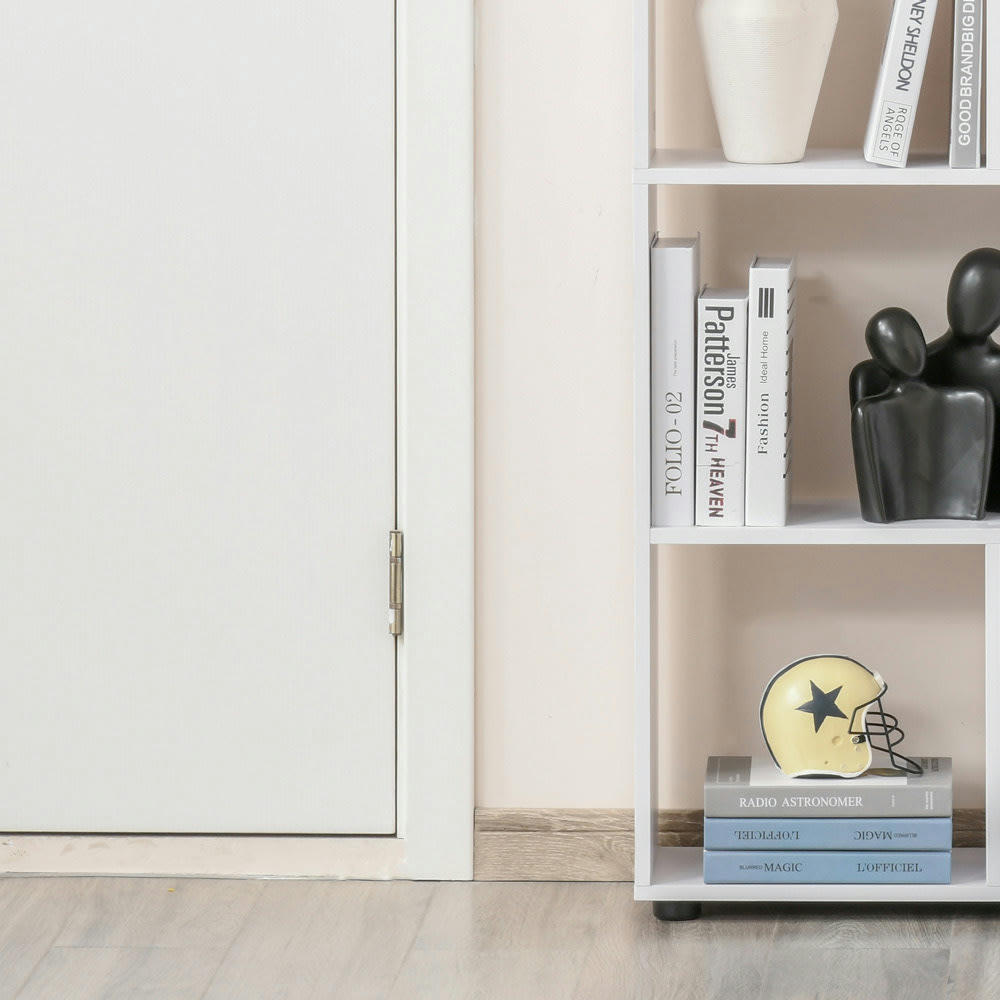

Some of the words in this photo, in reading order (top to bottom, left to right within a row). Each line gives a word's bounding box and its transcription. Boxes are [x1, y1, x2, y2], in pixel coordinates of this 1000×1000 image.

[896, 26, 921, 91] SHELDON
[879, 107, 894, 151] ANGELS
[958, 99, 970, 146] GOOD
[892, 142, 900, 158] OF
[760, 331, 768, 357] Home
[704, 306, 734, 415] Patterson
[726, 353, 740, 389] James
[760, 359, 768, 384] Ideal
[757, 393, 769, 455] Fashion
[708, 458, 725, 518] HEAVEN
[739, 797, 777, 808] RADIO
[782, 796, 863, 807] ASTRONOMER
[734, 831, 800, 840] L'OFFICIEL
[854, 831, 892, 840] MAGIC
[764, 863, 803, 873] MAGIC
[857, 863, 923, 873] L'OFFICIEL
